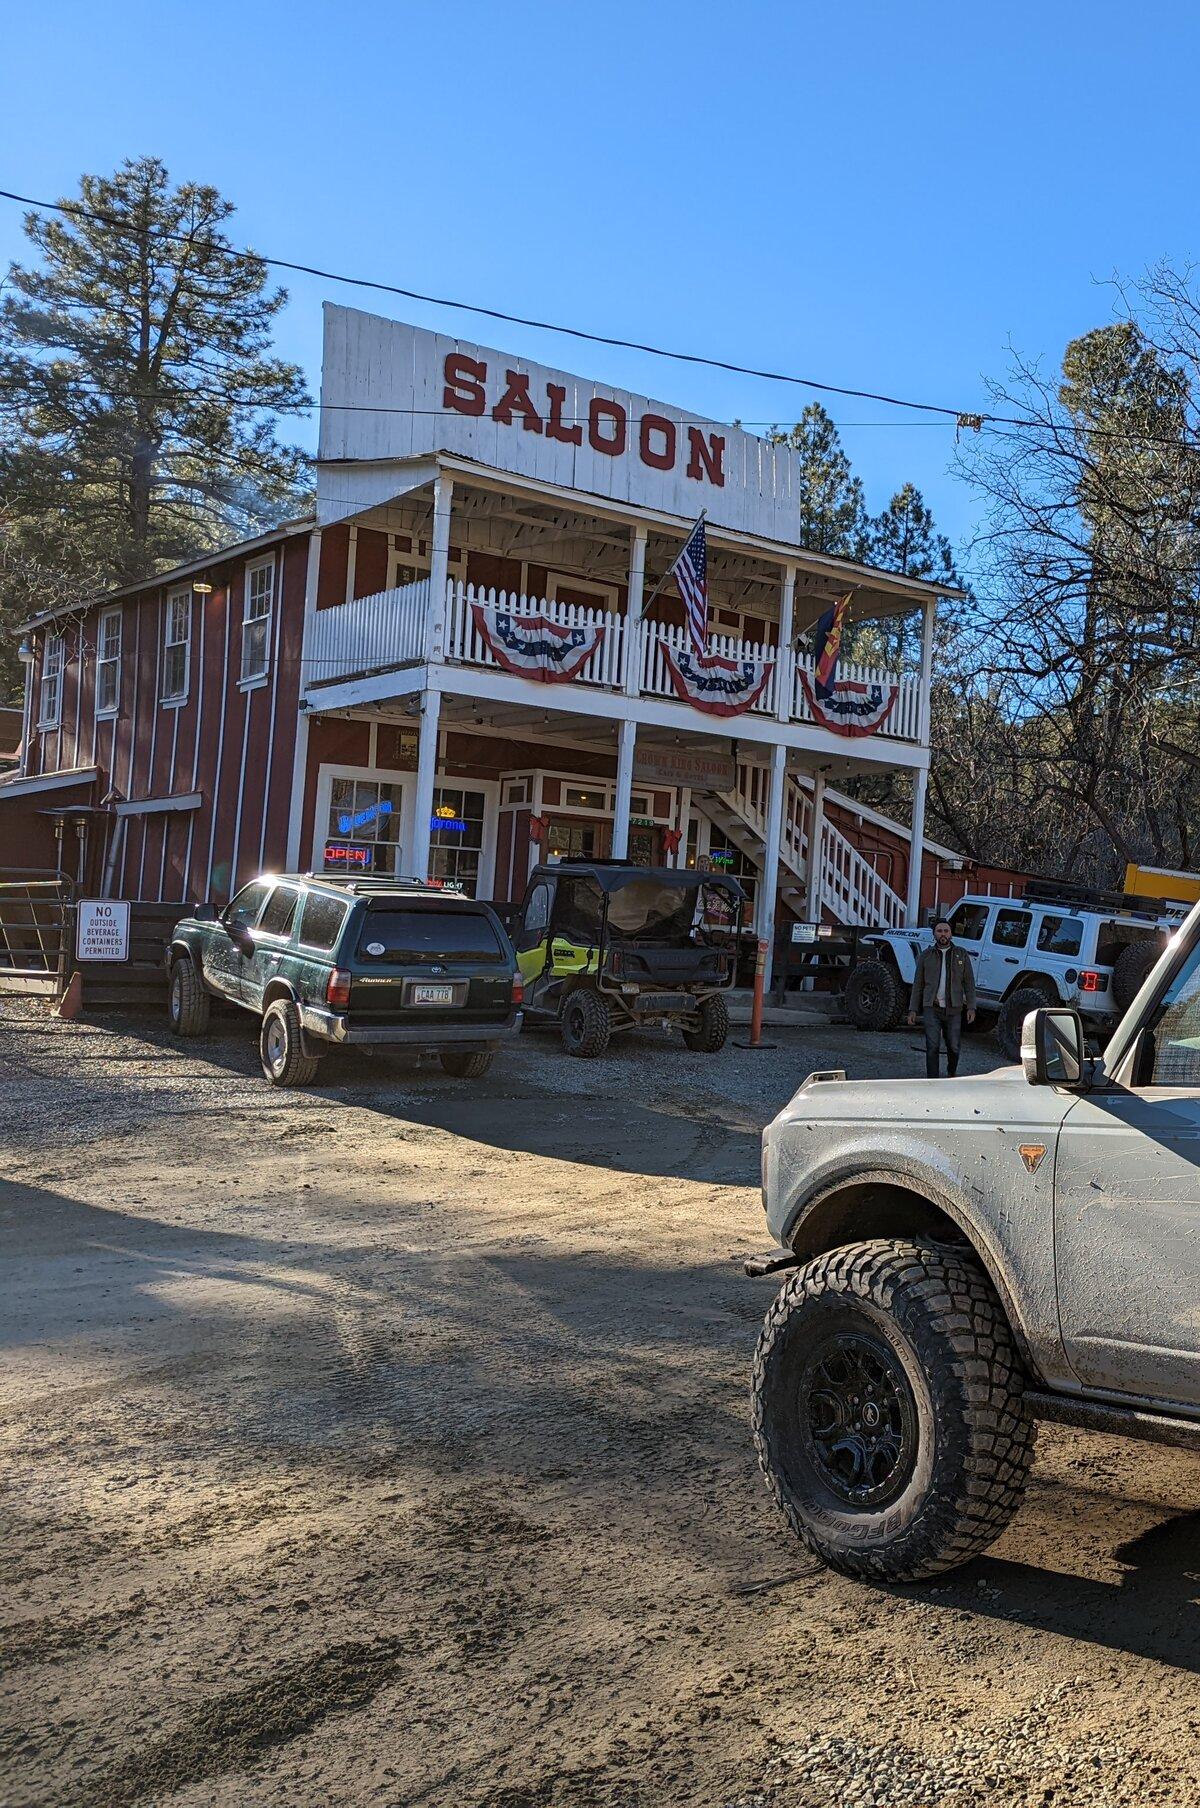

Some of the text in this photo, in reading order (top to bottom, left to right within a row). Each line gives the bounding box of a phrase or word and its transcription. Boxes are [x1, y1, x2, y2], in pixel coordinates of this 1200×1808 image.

[443, 352, 726, 488] SALOON
[324, 848, 366, 860] OPEN
[95, 906, 112, 917] NO
[90, 918, 117, 927] OUTSIDE
[86, 928, 120, 937] BEVERAGE
[887, 929, 921, 938] RUBICON
[82, 937, 123, 946] CONTAINERS
[85, 947, 120, 955] PERMITTED
